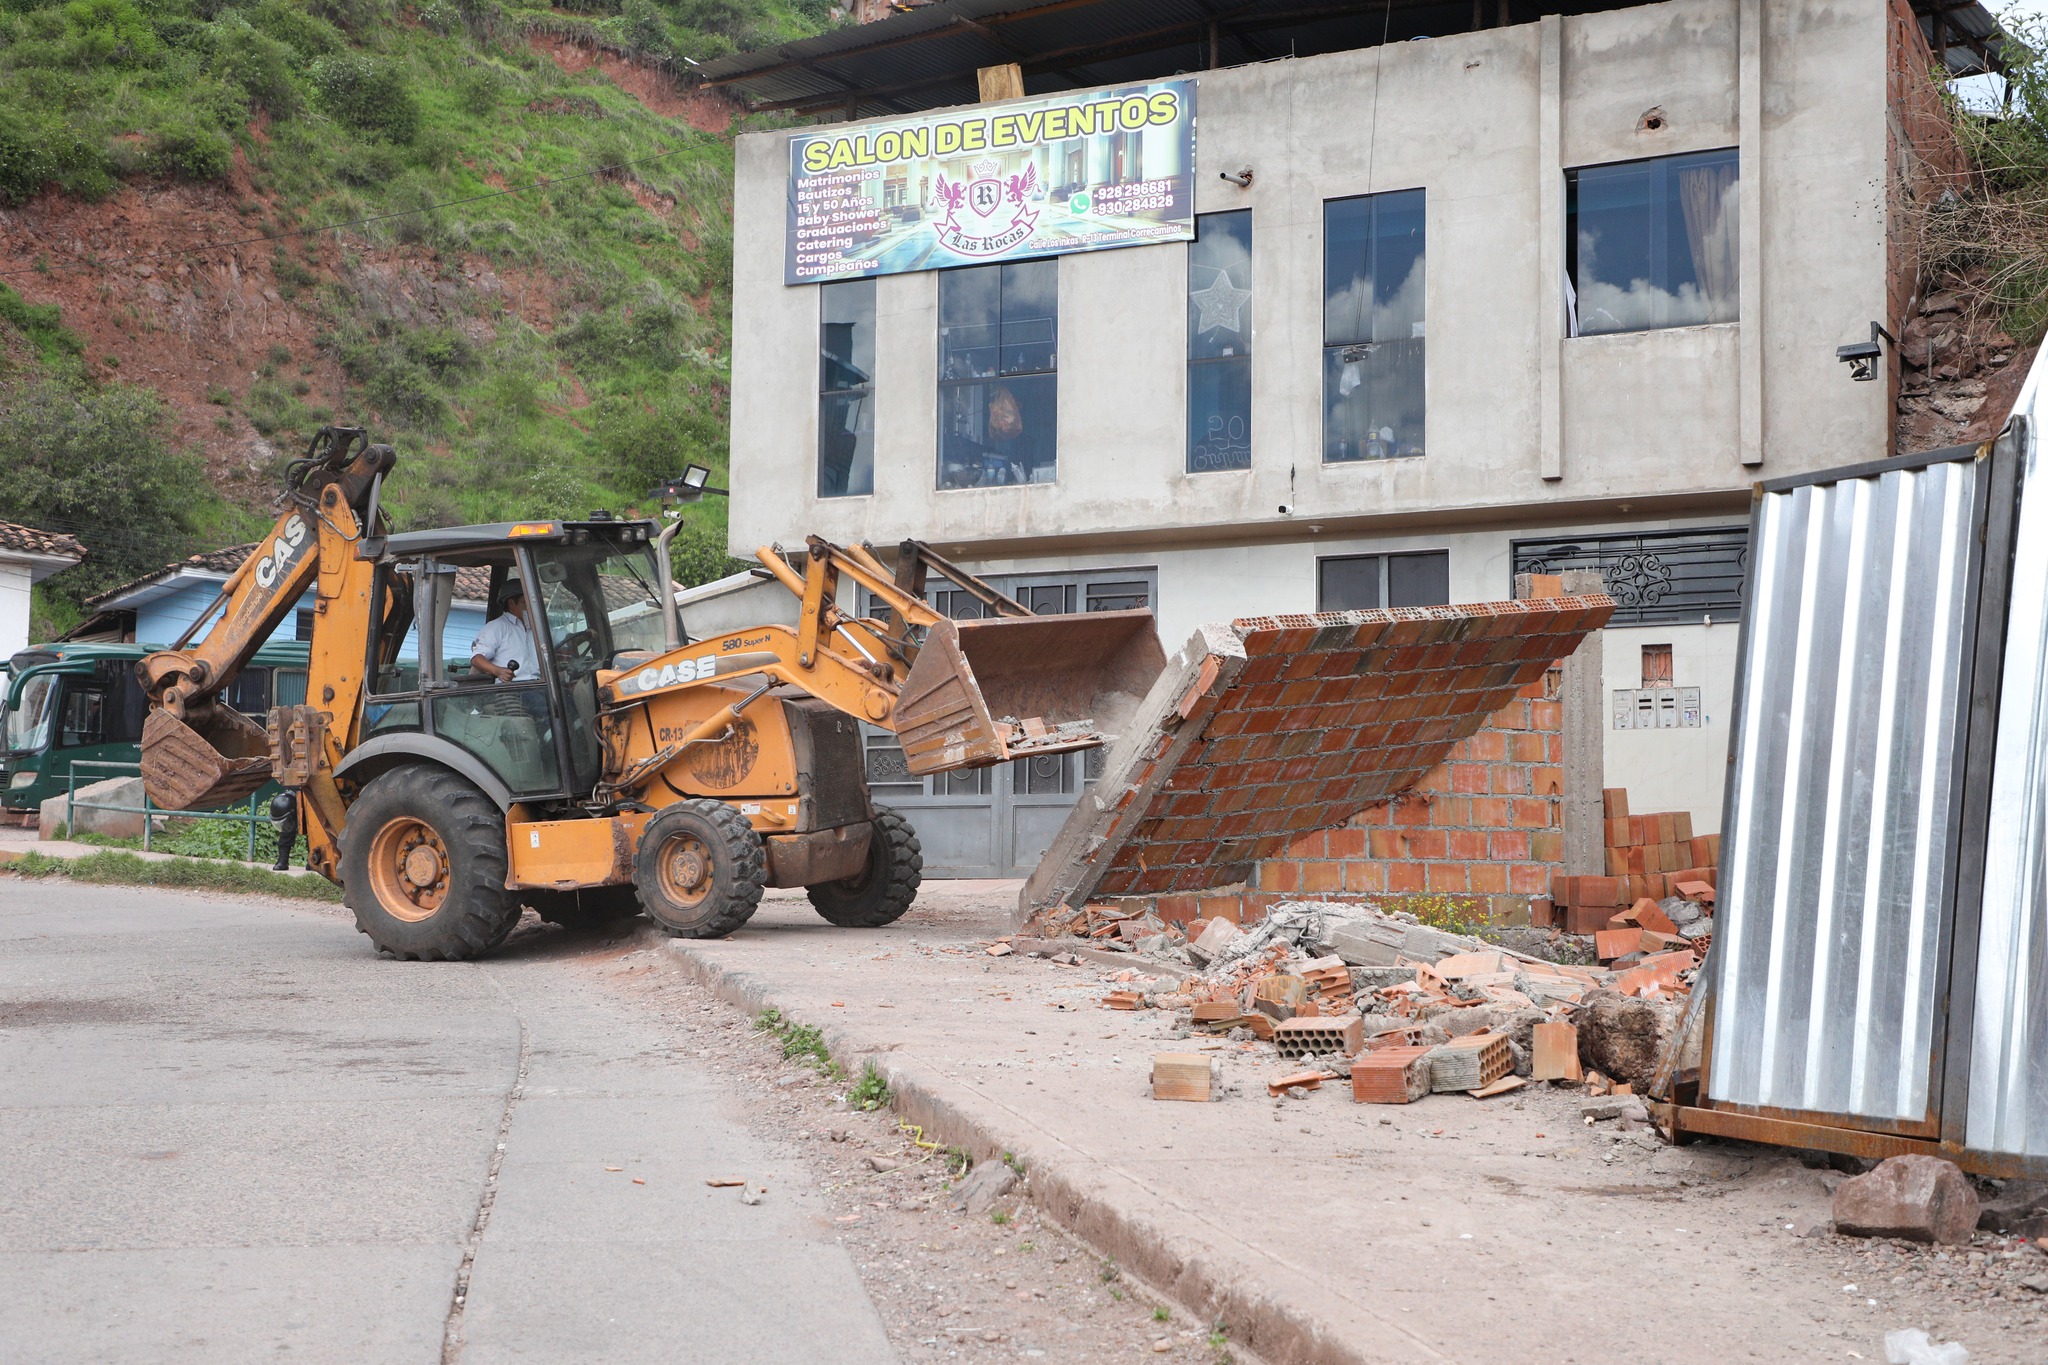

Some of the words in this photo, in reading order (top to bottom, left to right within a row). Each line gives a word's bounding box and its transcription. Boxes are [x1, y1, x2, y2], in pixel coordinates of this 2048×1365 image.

[805, 127, 929, 172] SALON
[936, 119, 986, 155] DE
[992, 92, 1177, 147] EVENTOS
[798, 170, 880, 189] Matrimonios
[1123, 180, 1171, 197] 296681
[798, 186, 852, 202] Bautizos
[798, 203, 809, 214] 15
[812, 203, 820, 214] y
[823, 199, 839, 210] 50
[841, 196, 874, 208] Años
[1124, 195, 1174, 212] 284828
[798, 213, 830, 227] Baby
[831, 208, 881, 223] Shower
[797, 220, 887, 239] Graduaciones
[1047, 238, 1059, 247] Los
[1099, 230, 1130, 242] Terminal
[1131, 224, 1182, 237] Correcaminos
[796, 236, 853, 251] Catering
[952, 232, 977, 251] Las
[982, 227, 1025, 251] Rocas
[796, 250, 842, 265] Cargos
[796, 258, 879, 277] Cumpleaños
[722, 637, 742, 652] 580
[743, 637, 764, 647] Super
[764, 634, 771, 642] N
[638, 654, 716, 691] CASE
[659, 727, 683, 742] CR-13
